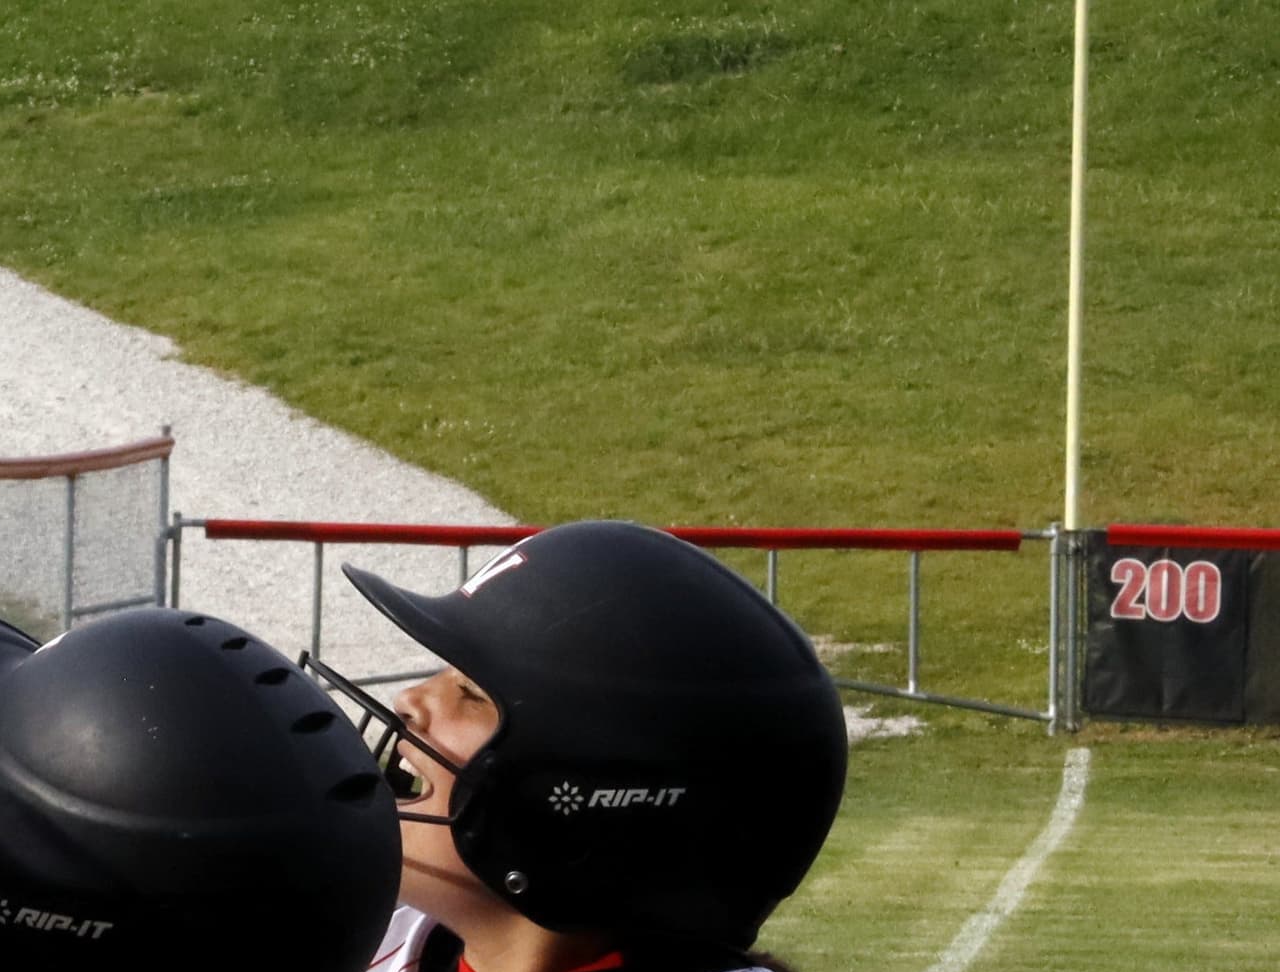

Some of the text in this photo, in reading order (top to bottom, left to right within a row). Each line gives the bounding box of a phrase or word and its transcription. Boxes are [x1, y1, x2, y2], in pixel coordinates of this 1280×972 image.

[1110, 558, 1221, 623] 200
[587, 788, 686, 808] RIP-IT
[13, 907, 114, 940] RIP-IT
